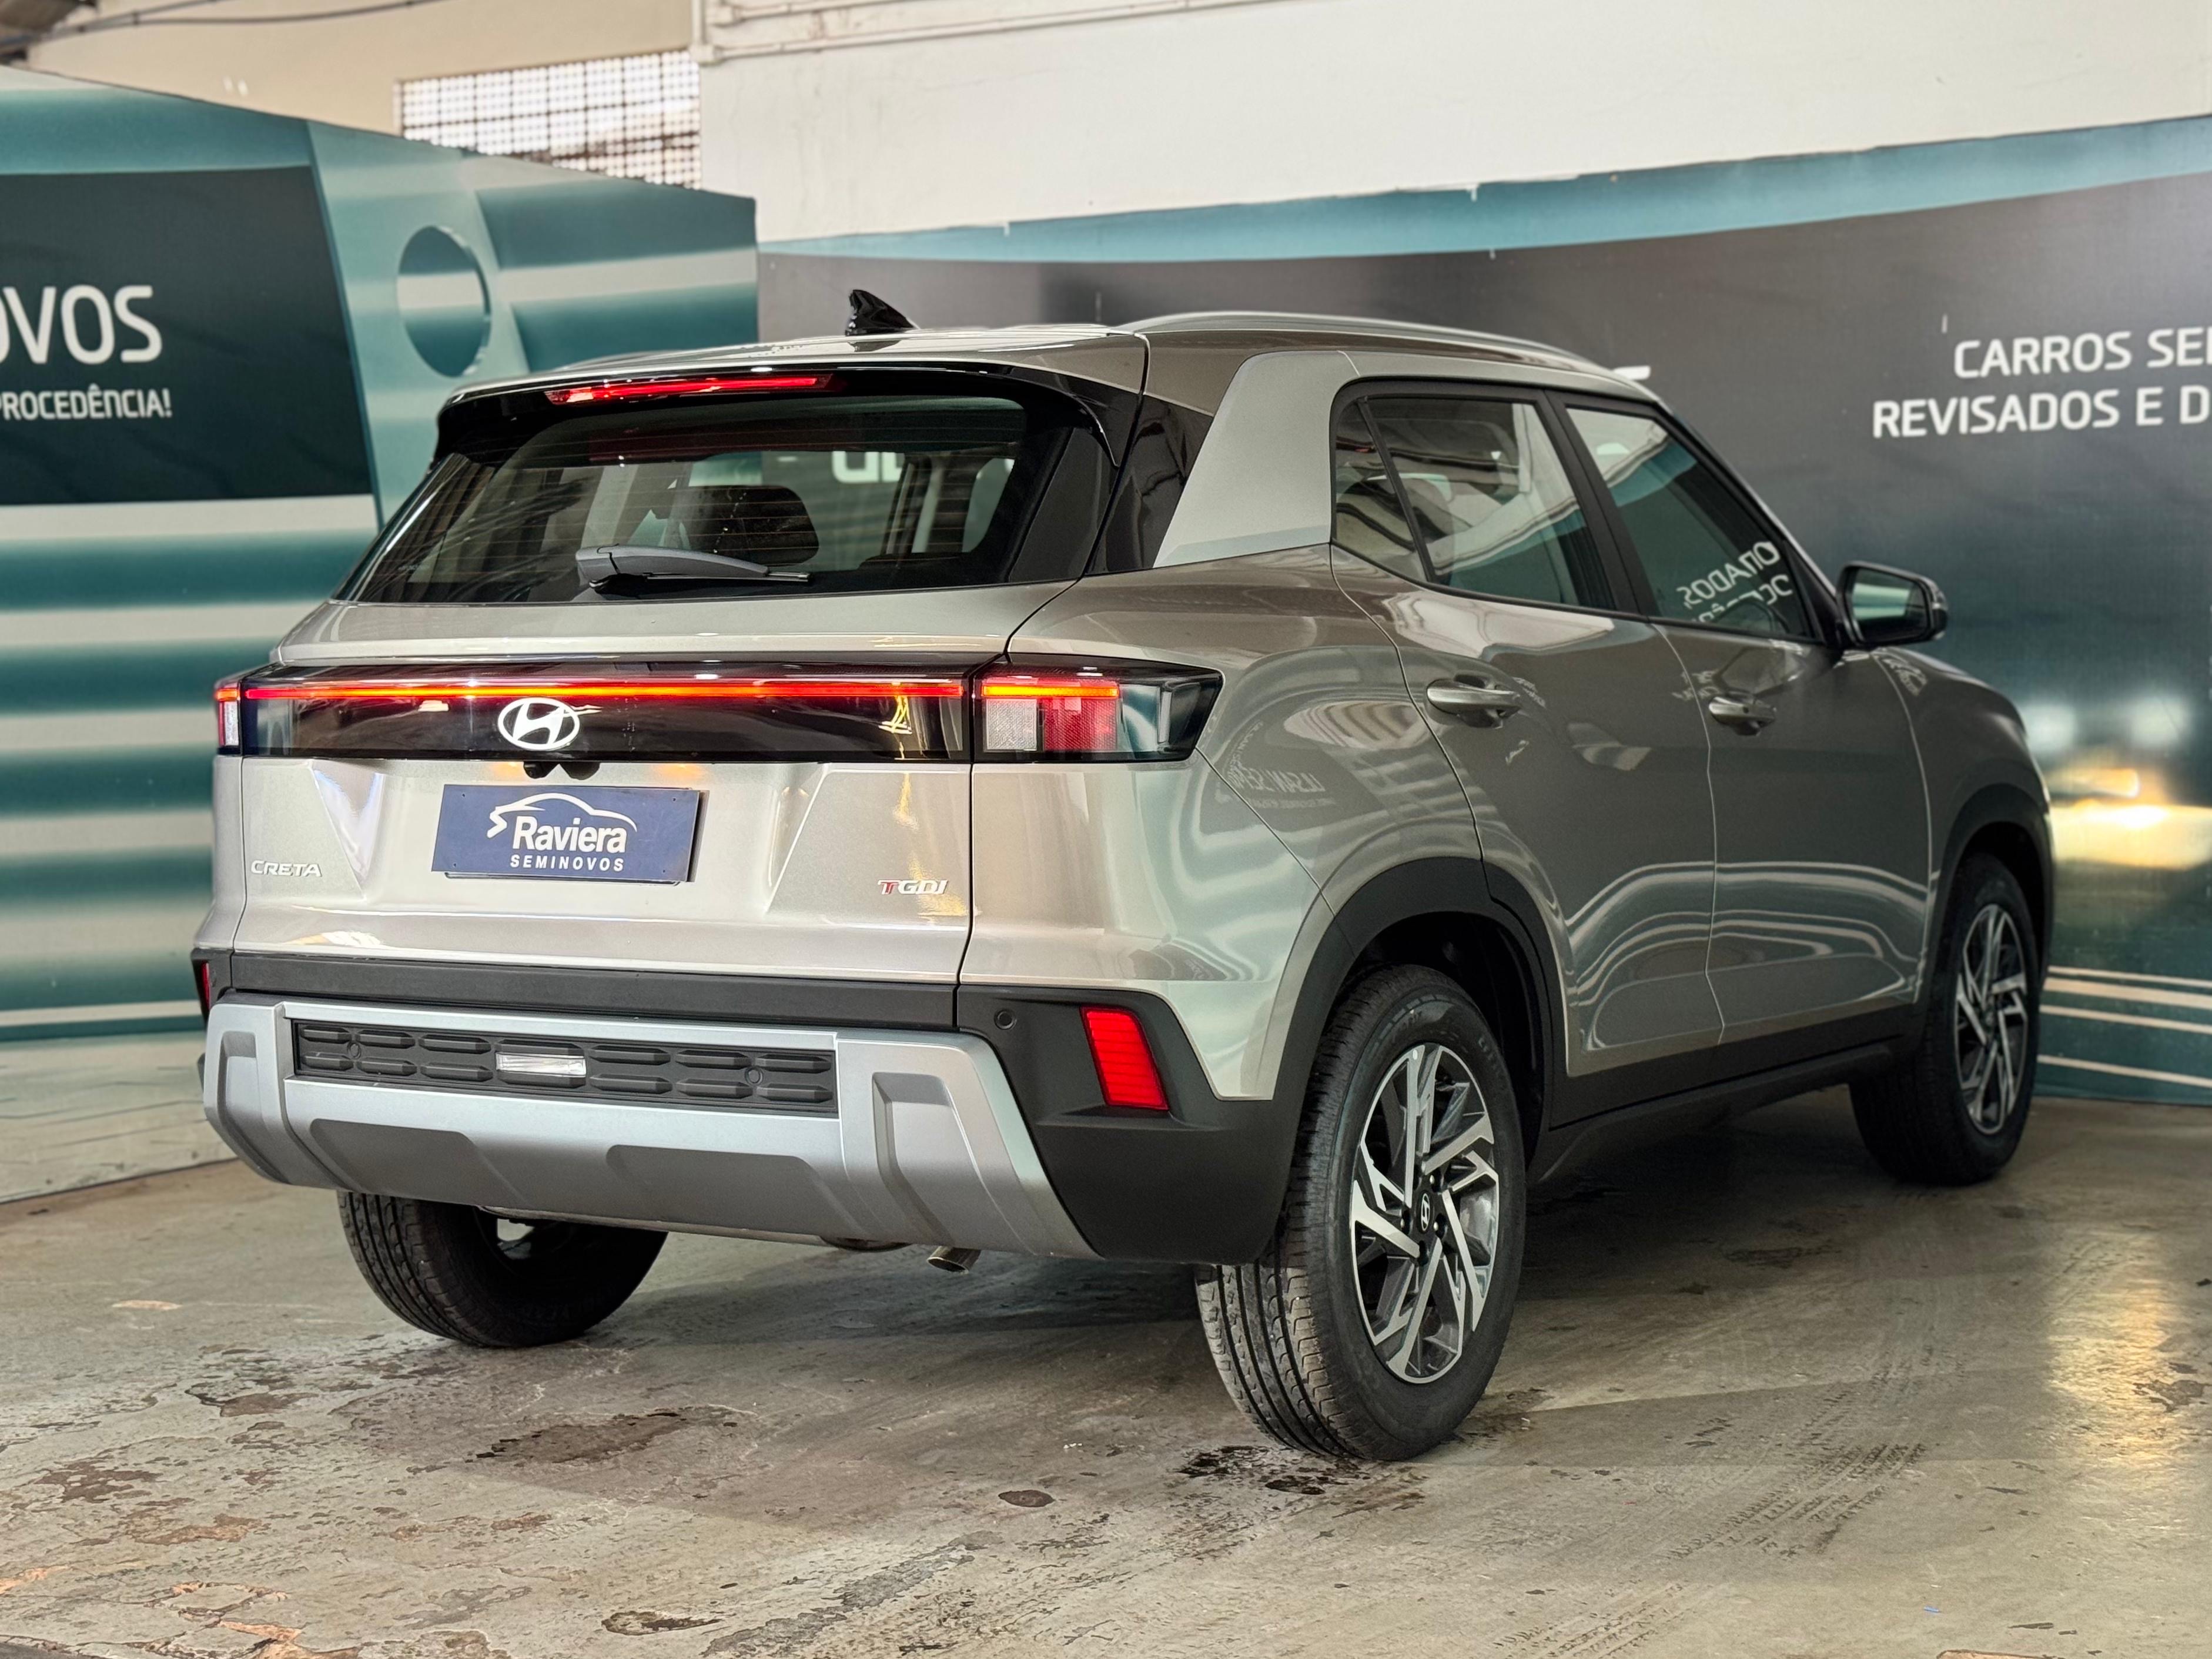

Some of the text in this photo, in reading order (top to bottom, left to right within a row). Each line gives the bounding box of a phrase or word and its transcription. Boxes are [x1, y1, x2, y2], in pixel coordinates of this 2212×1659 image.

[0, 284, 163, 364] VOS
[1954, 326, 2212, 379] CARROS SE
[0, 383, 173, 421] ROCEDÊNCIA!
[1873, 384, 2211, 439] REVISADOS E D
[512, 815, 627, 854] Raviera
[250, 859, 323, 878] CRETA
[510, 854, 624, 872] SEMINOVOS
[877, 879, 949, 895] TGDI
